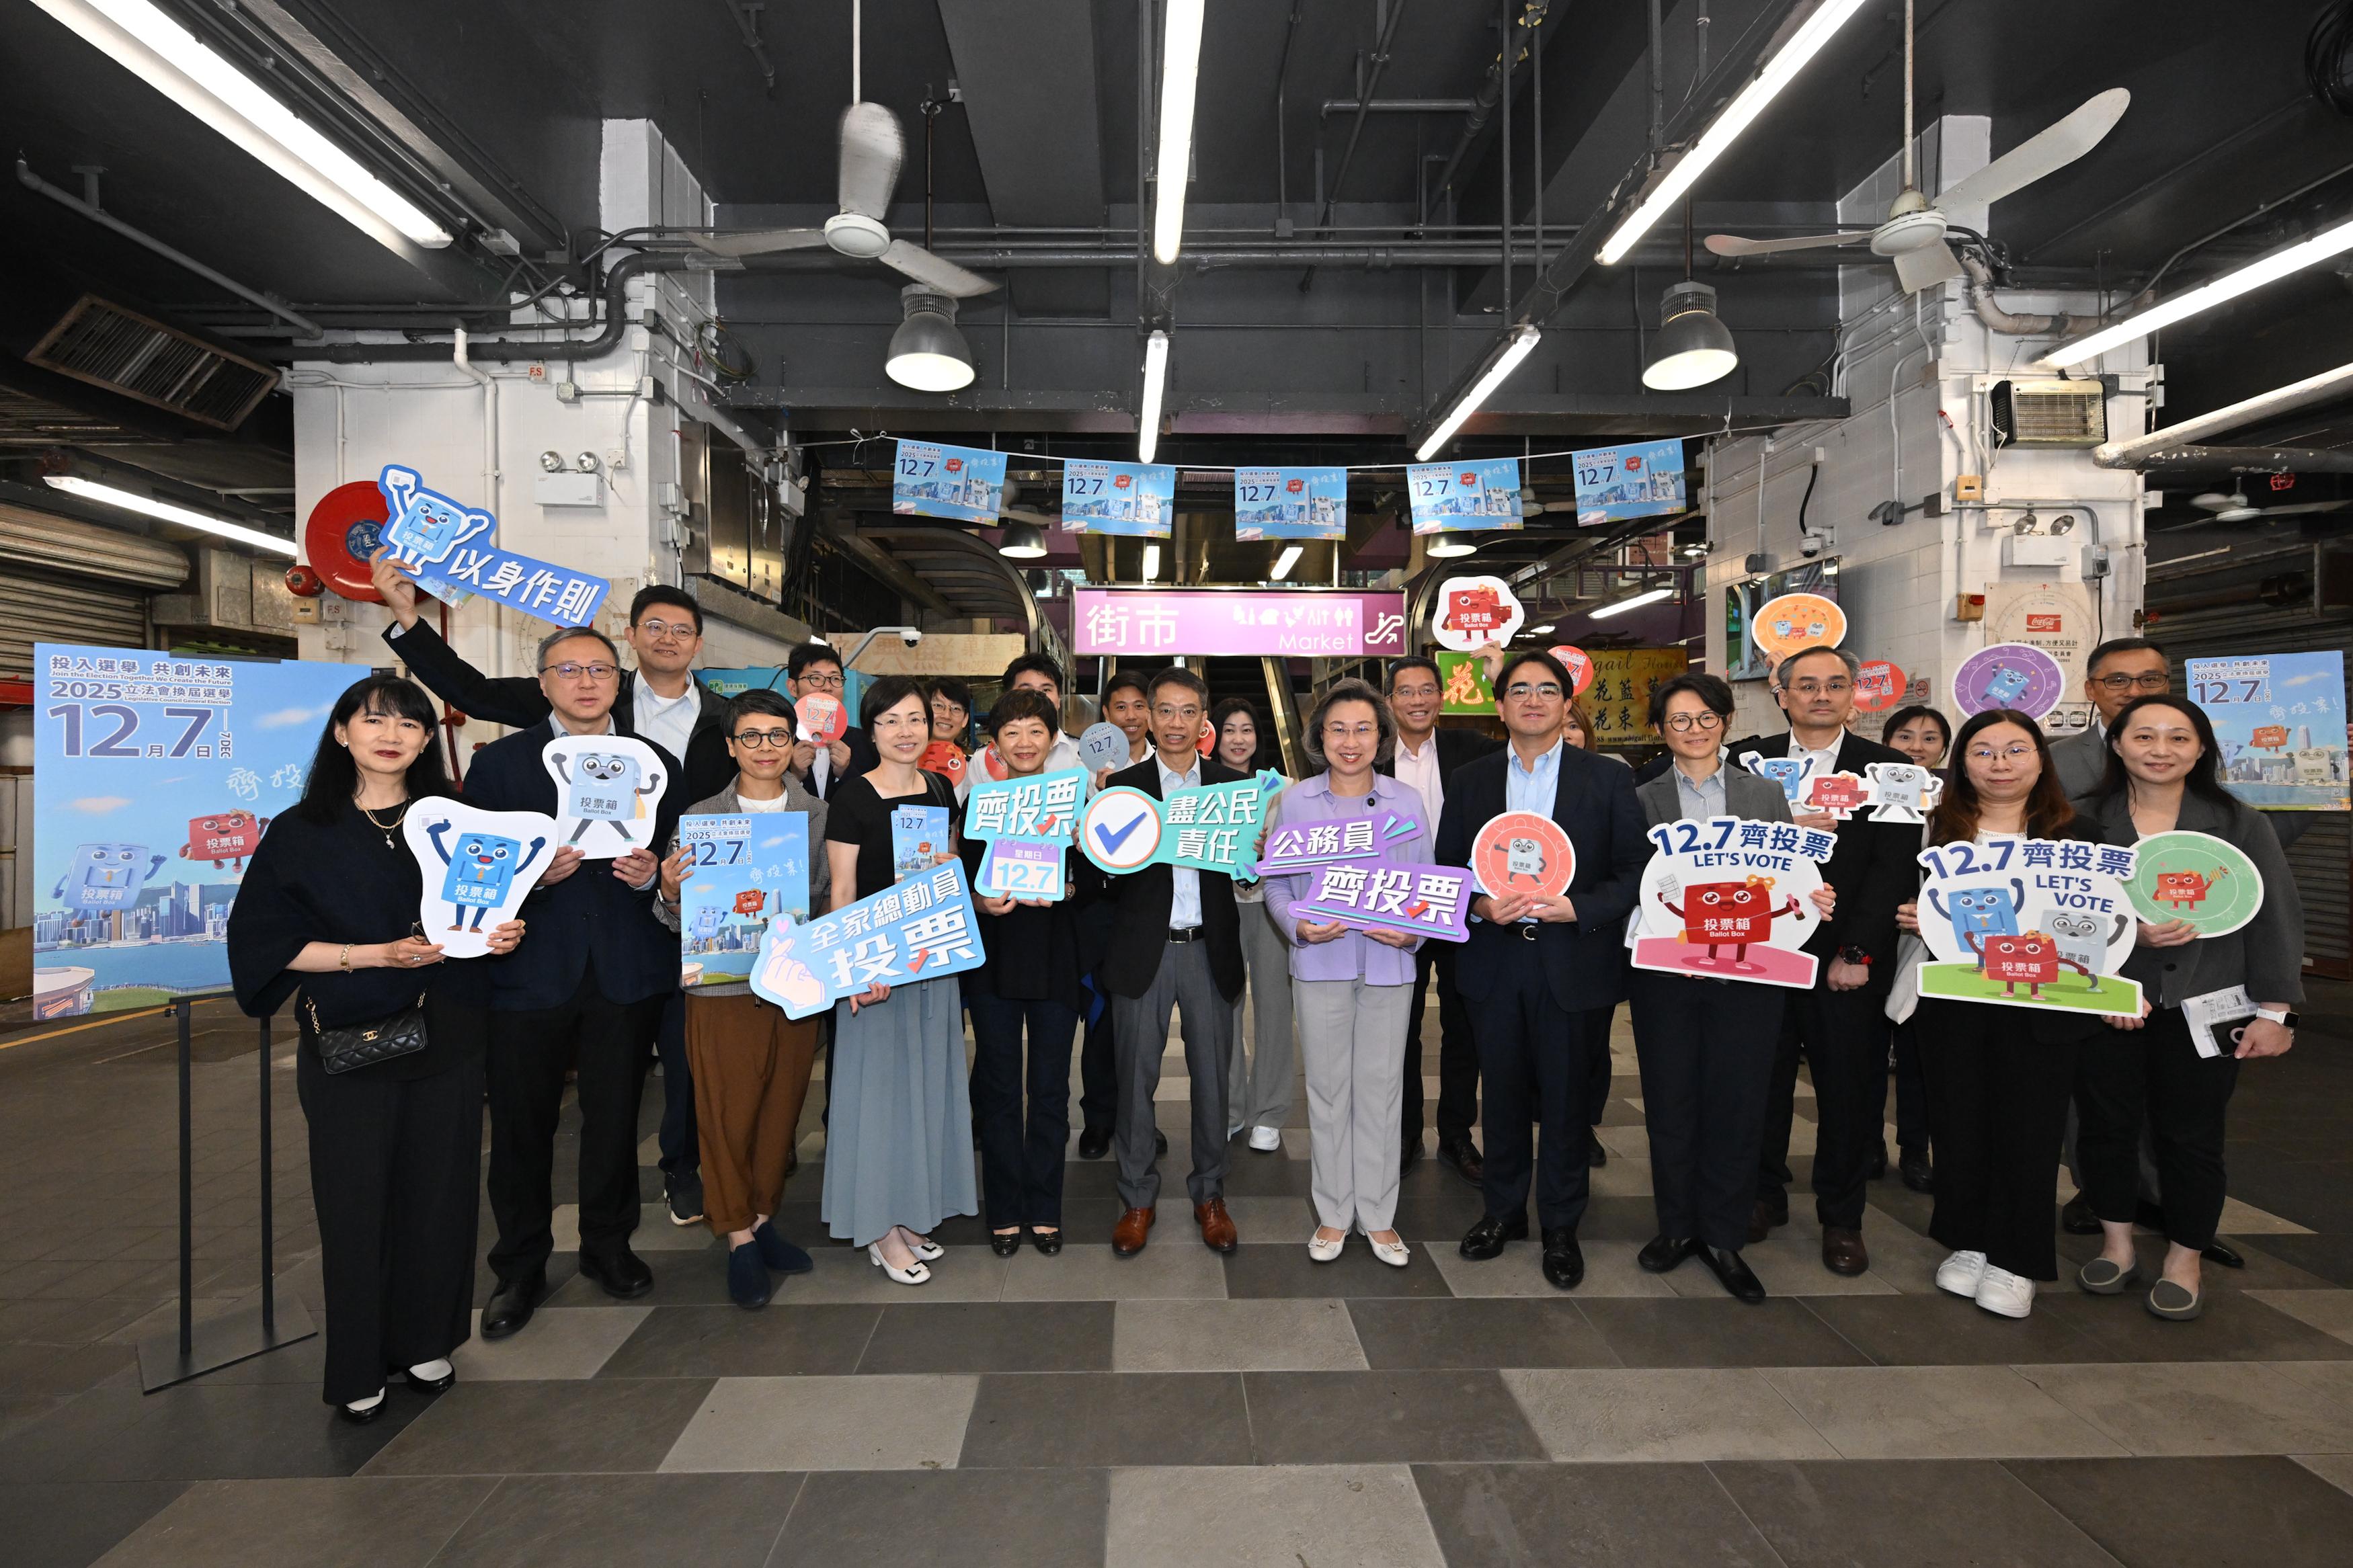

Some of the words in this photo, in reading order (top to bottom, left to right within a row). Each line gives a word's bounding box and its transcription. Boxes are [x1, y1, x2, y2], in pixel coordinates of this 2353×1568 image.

[448, 548, 600, 624] 以身作則
[1086, 604, 1179, 647] 街市
[1460, 612, 1492, 623] 投票箱
[1279, 632, 1354, 651] Market
[52, 656, 137, 673] 投入選舉
[153, 663, 231, 678] 共創未來
[1590, 651, 1634, 677] gail
[52, 681, 122, 700] 2025
[125, 684, 231, 698] 立法會換屆選舉
[1443, 661, 1484, 705] 花
[580, 797, 618, 810] 投票箱
[973, 776, 1080, 837] 齊投票
[1166, 788, 1259, 825] 盡公民
[1821, 794, 1849, 802] 投票箱
[206, 835, 244, 850] 投票箱
[686, 831, 711, 839] 2025
[1272, 821, 1374, 858] 公務員
[1653, 821, 1735, 856] 12.7
[1740, 823, 1833, 860] 齊投票
[1014, 850, 1042, 860] 星期日
[1176, 829, 1239, 865] 責任
[1694, 852, 1740, 868] LET'S
[1744, 854, 1792, 872] VOTE
[1923, 840, 2015, 879] 12.7
[2022, 842, 2135, 877] 齊投票
[998, 862, 1054, 890] 12.7
[2036, 874, 2091, 892] LET'S
[81, 889, 124, 901] 投票箱
[454, 884, 497, 900] 投票箱
[1316, 864, 1464, 926] 齊投票
[811, 868, 963, 954] 全家總動員
[2054, 893, 2114, 913] VOTE
[1704, 917, 1750, 931] 投票箱
[828, 904, 978, 989] 投票
[2001, 962, 2040, 973] 投票箱
